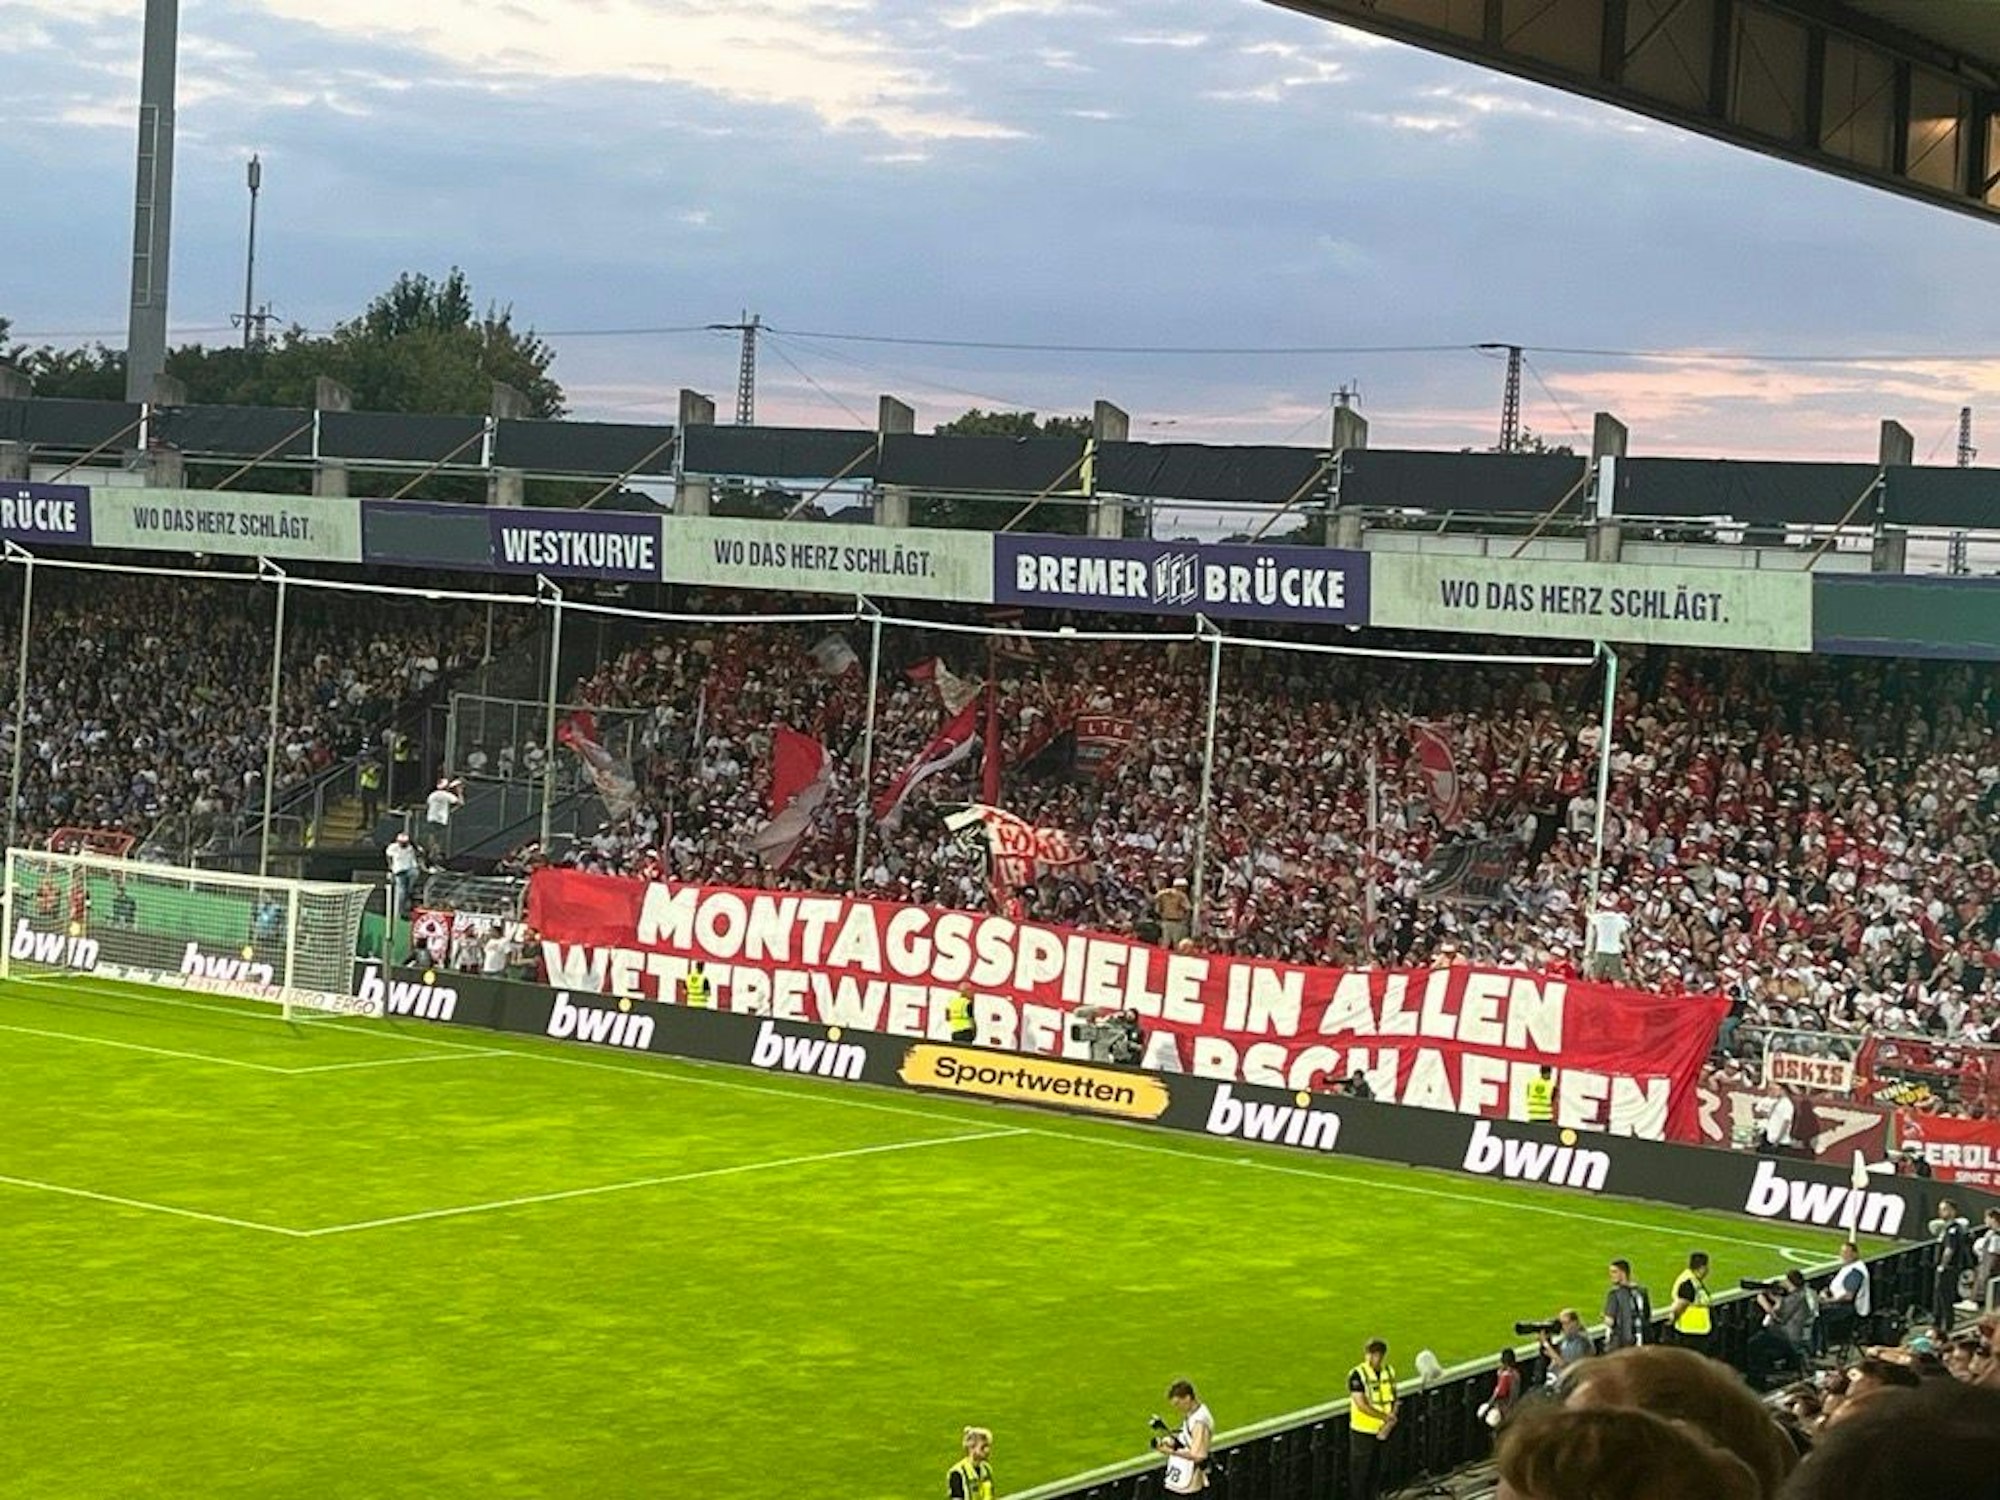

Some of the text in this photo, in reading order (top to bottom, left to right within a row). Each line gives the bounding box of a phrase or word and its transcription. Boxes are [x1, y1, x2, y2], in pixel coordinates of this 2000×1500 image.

[133, 507, 315, 541] WO DAS HERZ SCHLÄGT.
[502, 527, 656, 571] WESTKURVE
[714, 539, 936, 579] WO DAS HERZ SCHLÄGT.
[1017, 554, 1148, 598] BREMER
[1204, 557, 1345, 609] BRÜCKE
[1441, 579, 1730, 624] WO DAS HERZ SCHLÄGT.
[10, 917, 100, 971] bwin
[637, 882, 1568, 1055] MONTAGSSPIELE IN ALLEN
[359, 965, 457, 1021] bwin
[547, 992, 656, 1050] bwin
[750, 1020, 867, 1082] bwin
[934, 1056, 1136, 1107] Sportwetten
[1205, 1083, 1343, 1153] bwin
[1463, 1120, 1612, 1192] bwin
[1901, 1139, 2000, 1172] EROL
[1745, 1161, 1906, 1236] bwin
